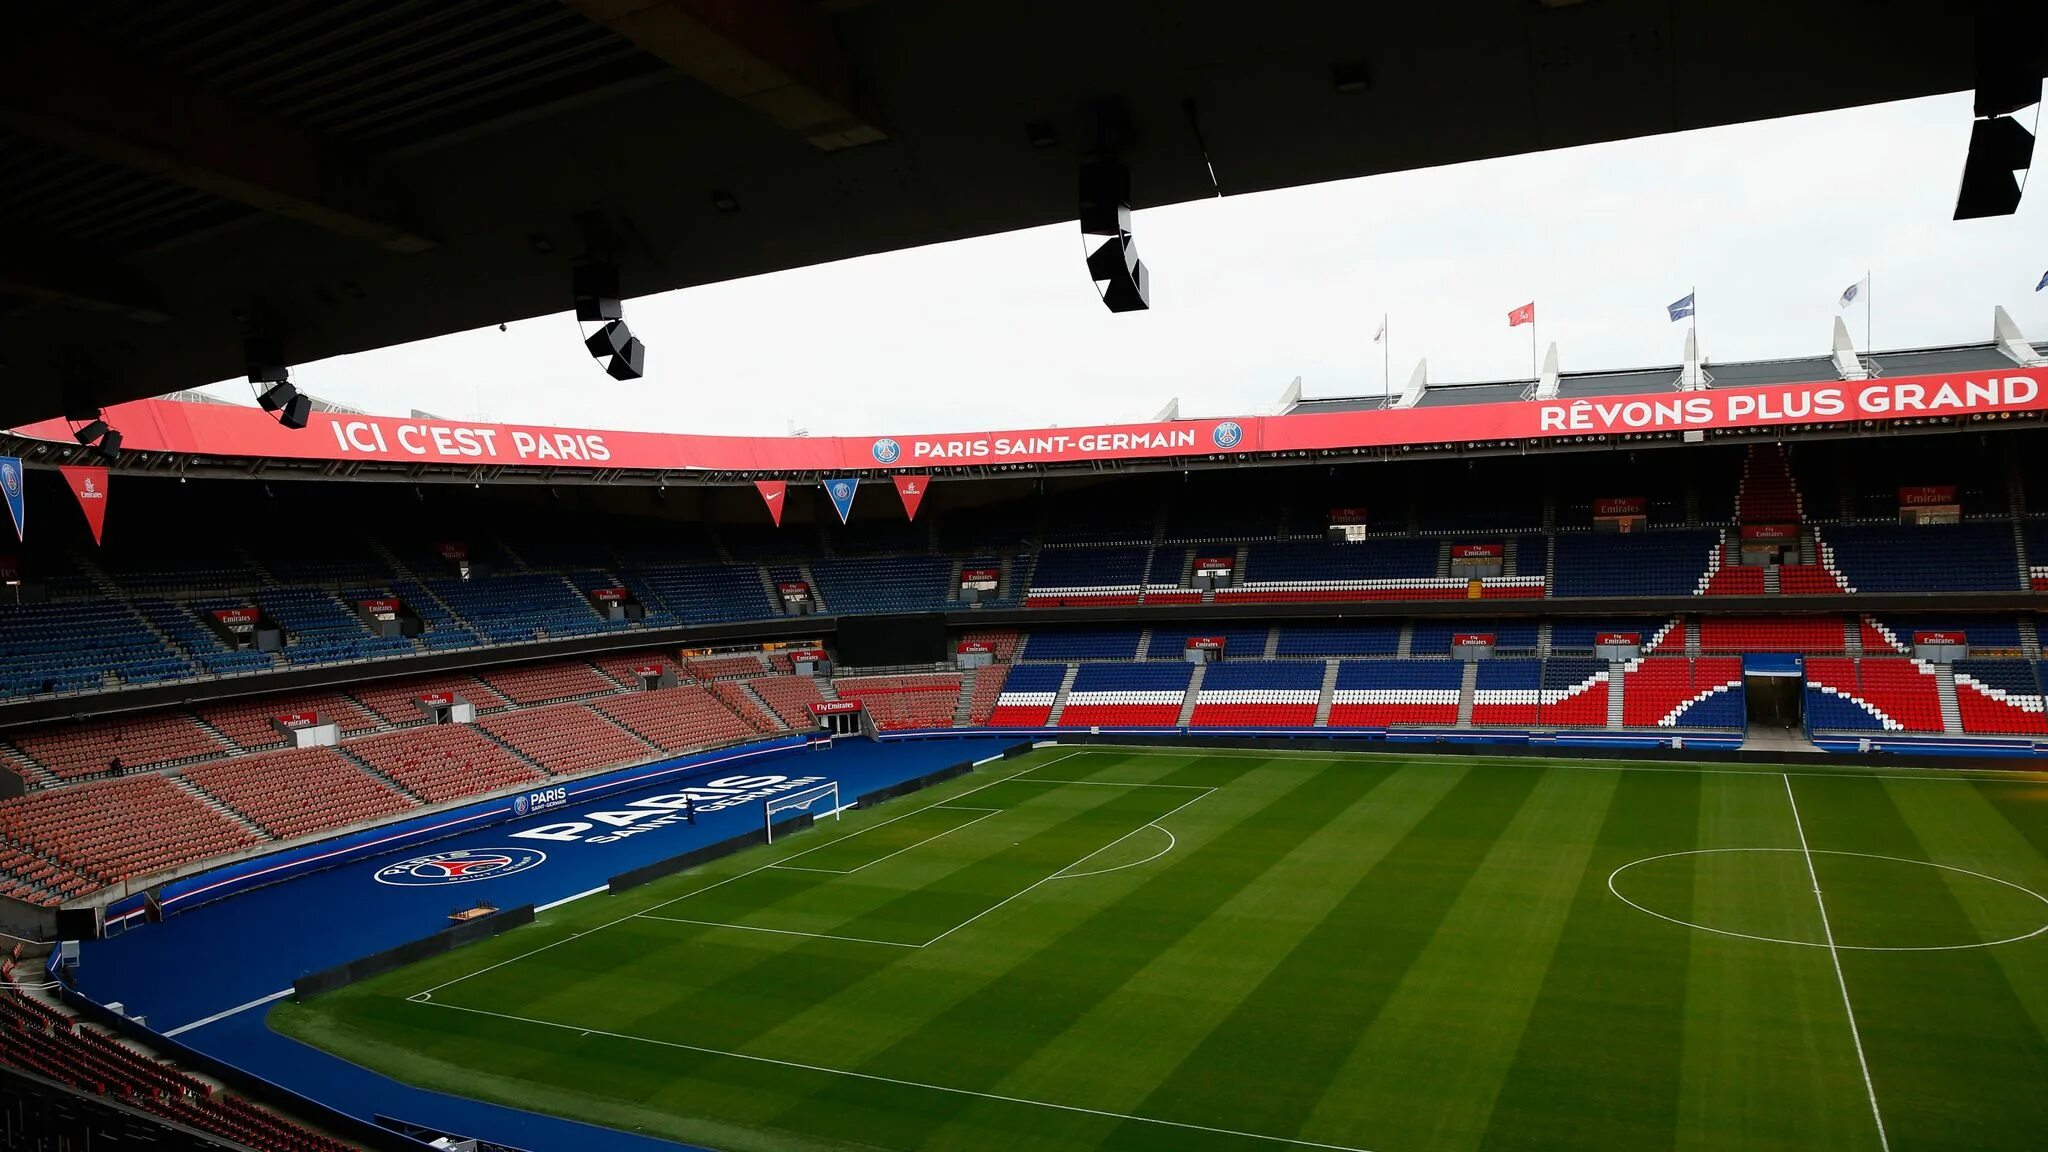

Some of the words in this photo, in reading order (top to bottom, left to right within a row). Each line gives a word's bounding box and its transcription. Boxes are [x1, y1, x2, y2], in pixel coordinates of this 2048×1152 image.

[1540, 398, 1713, 431] RÊVONS
[1728, 388, 1844, 421] PLUS
[1858, 376, 2038, 412] GRAND
[331, 420, 388, 453] ICI
[397, 424, 497, 456] C'EST
[512, 431, 611, 461] PARIS
[914, 439, 989, 459] PARIS
[994, 429, 1195, 456] SAINT-GERMAIN
[1601, 505, 1640, 514] Emirates
[1906, 494, 1952, 504] Emirates
[223, 615, 251, 623] Emirates
[508, 775, 788, 842] PARIS
[531, 787, 566, 806] PARIS
